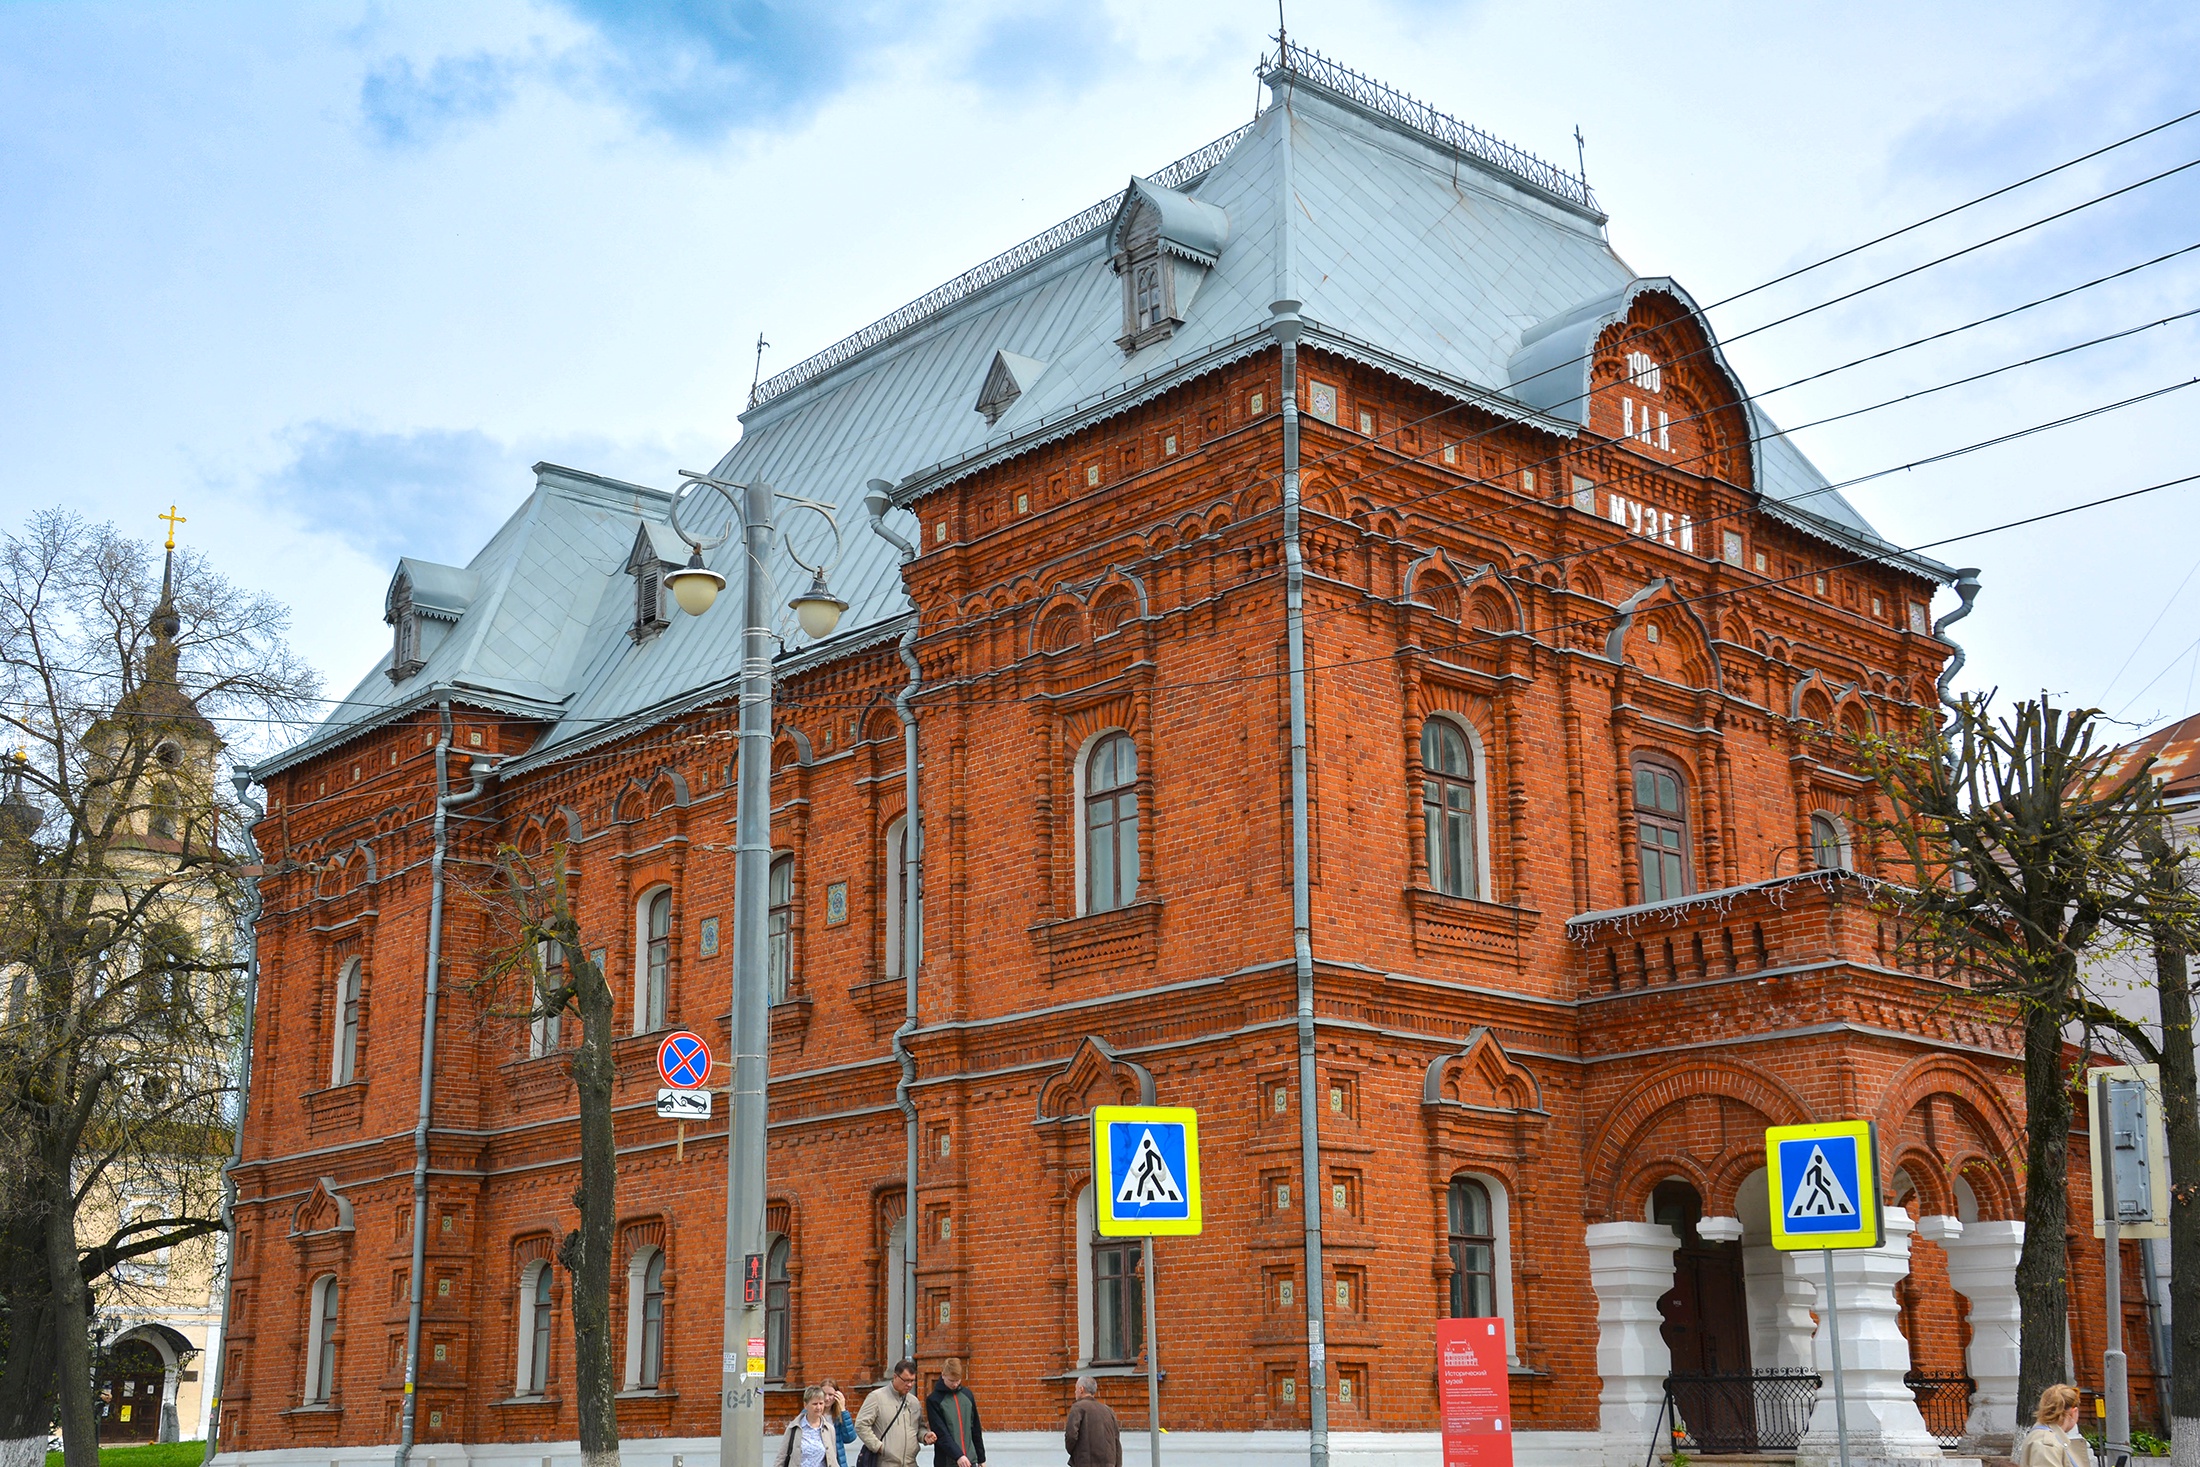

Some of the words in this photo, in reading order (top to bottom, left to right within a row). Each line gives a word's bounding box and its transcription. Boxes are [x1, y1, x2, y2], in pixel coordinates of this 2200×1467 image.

[1625, 351, 1660, 393] 1900
[1609, 494, 1694, 552] МУЗЕЙ
[745, 1279, 763, 1302] 61
[726, 1388, 753, 1409] 64
